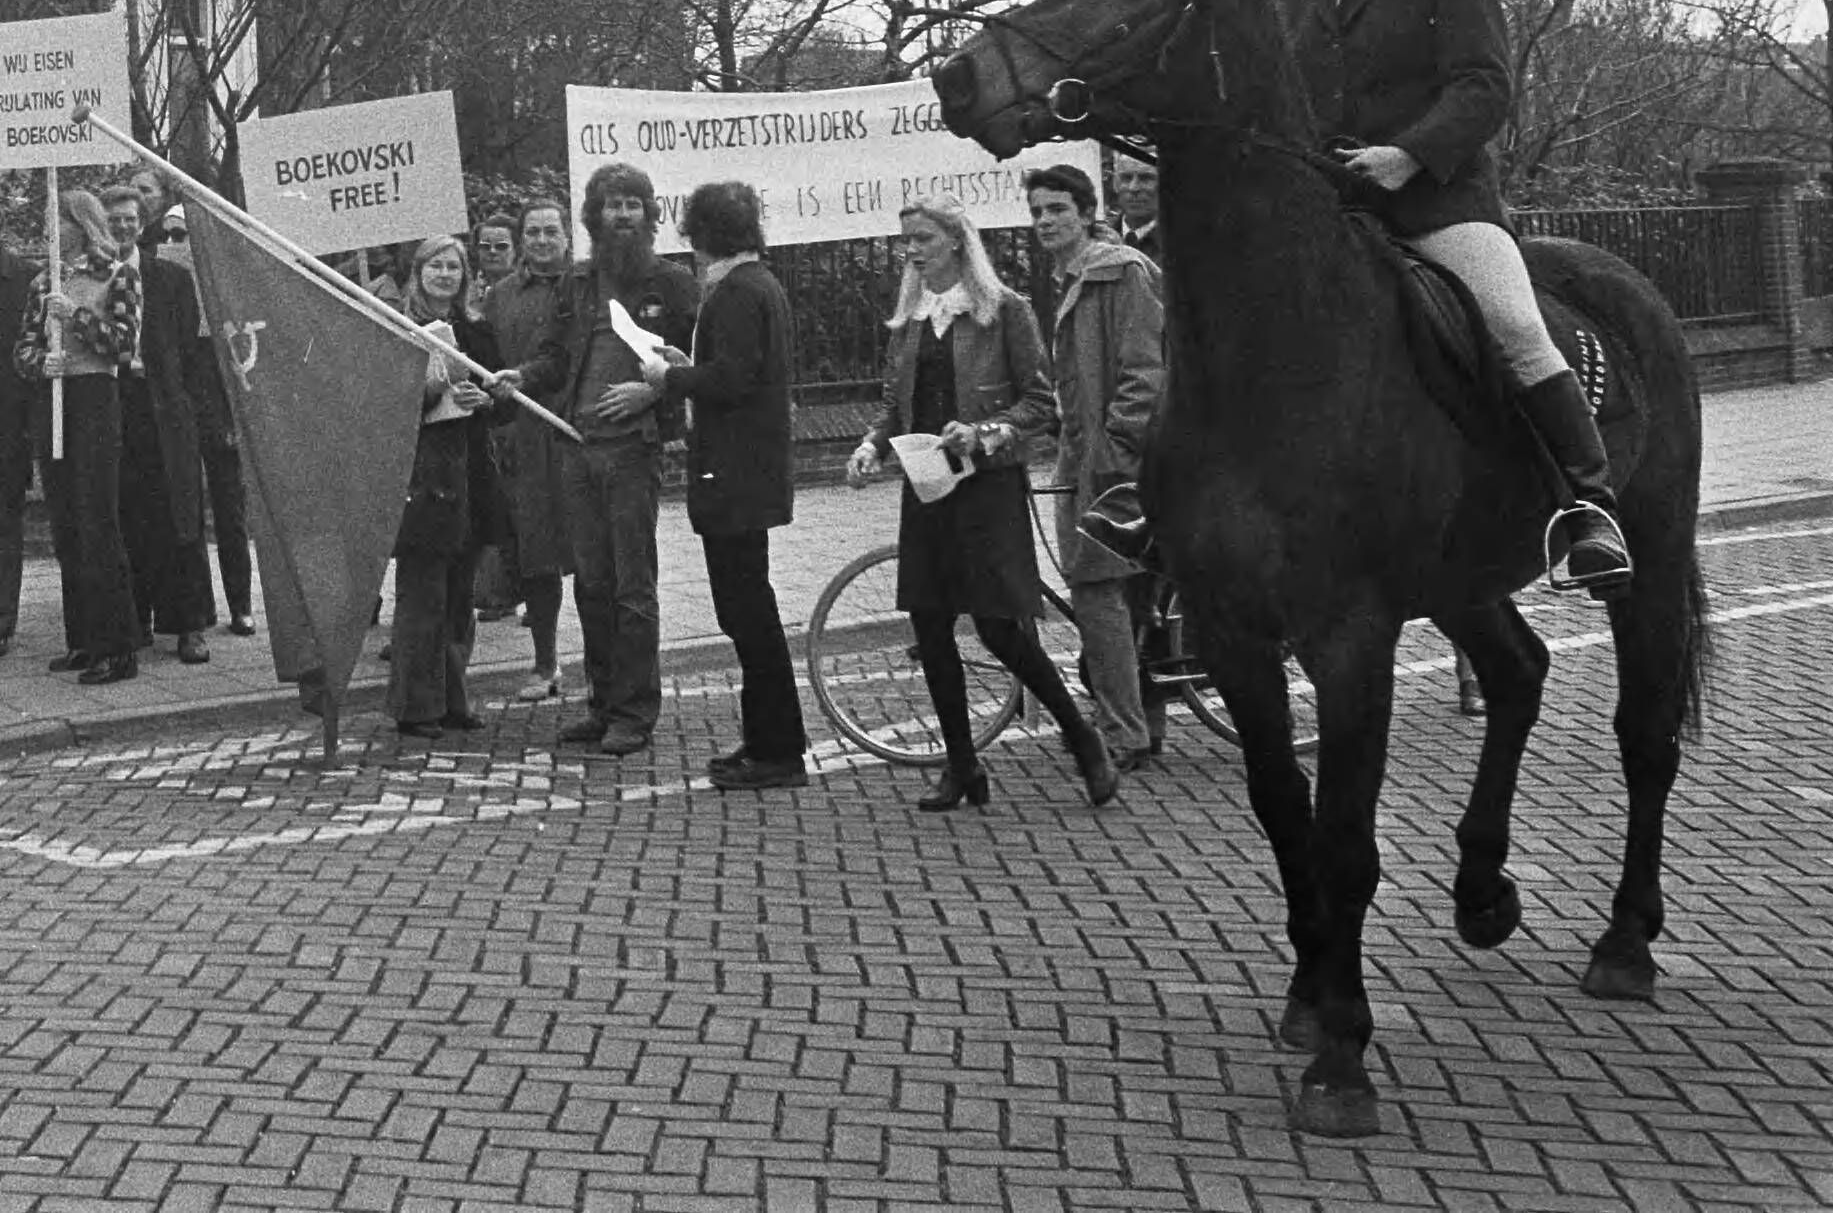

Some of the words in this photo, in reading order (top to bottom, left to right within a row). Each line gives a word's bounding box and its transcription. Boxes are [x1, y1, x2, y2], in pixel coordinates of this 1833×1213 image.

[33, 50, 74, 73] EISEN
[71, 87, 101, 108] VAN
[6, 123, 93, 148] BOEKOVSKI
[637, 108, 868, 153] OUD-VERZETSTRIJDERS
[888, 101, 949, 136] ZEGG
[275, 139, 415, 187] BOEKOVSKI
[797, 185, 821, 218] IS
[844, 178, 882, 215] EEN
